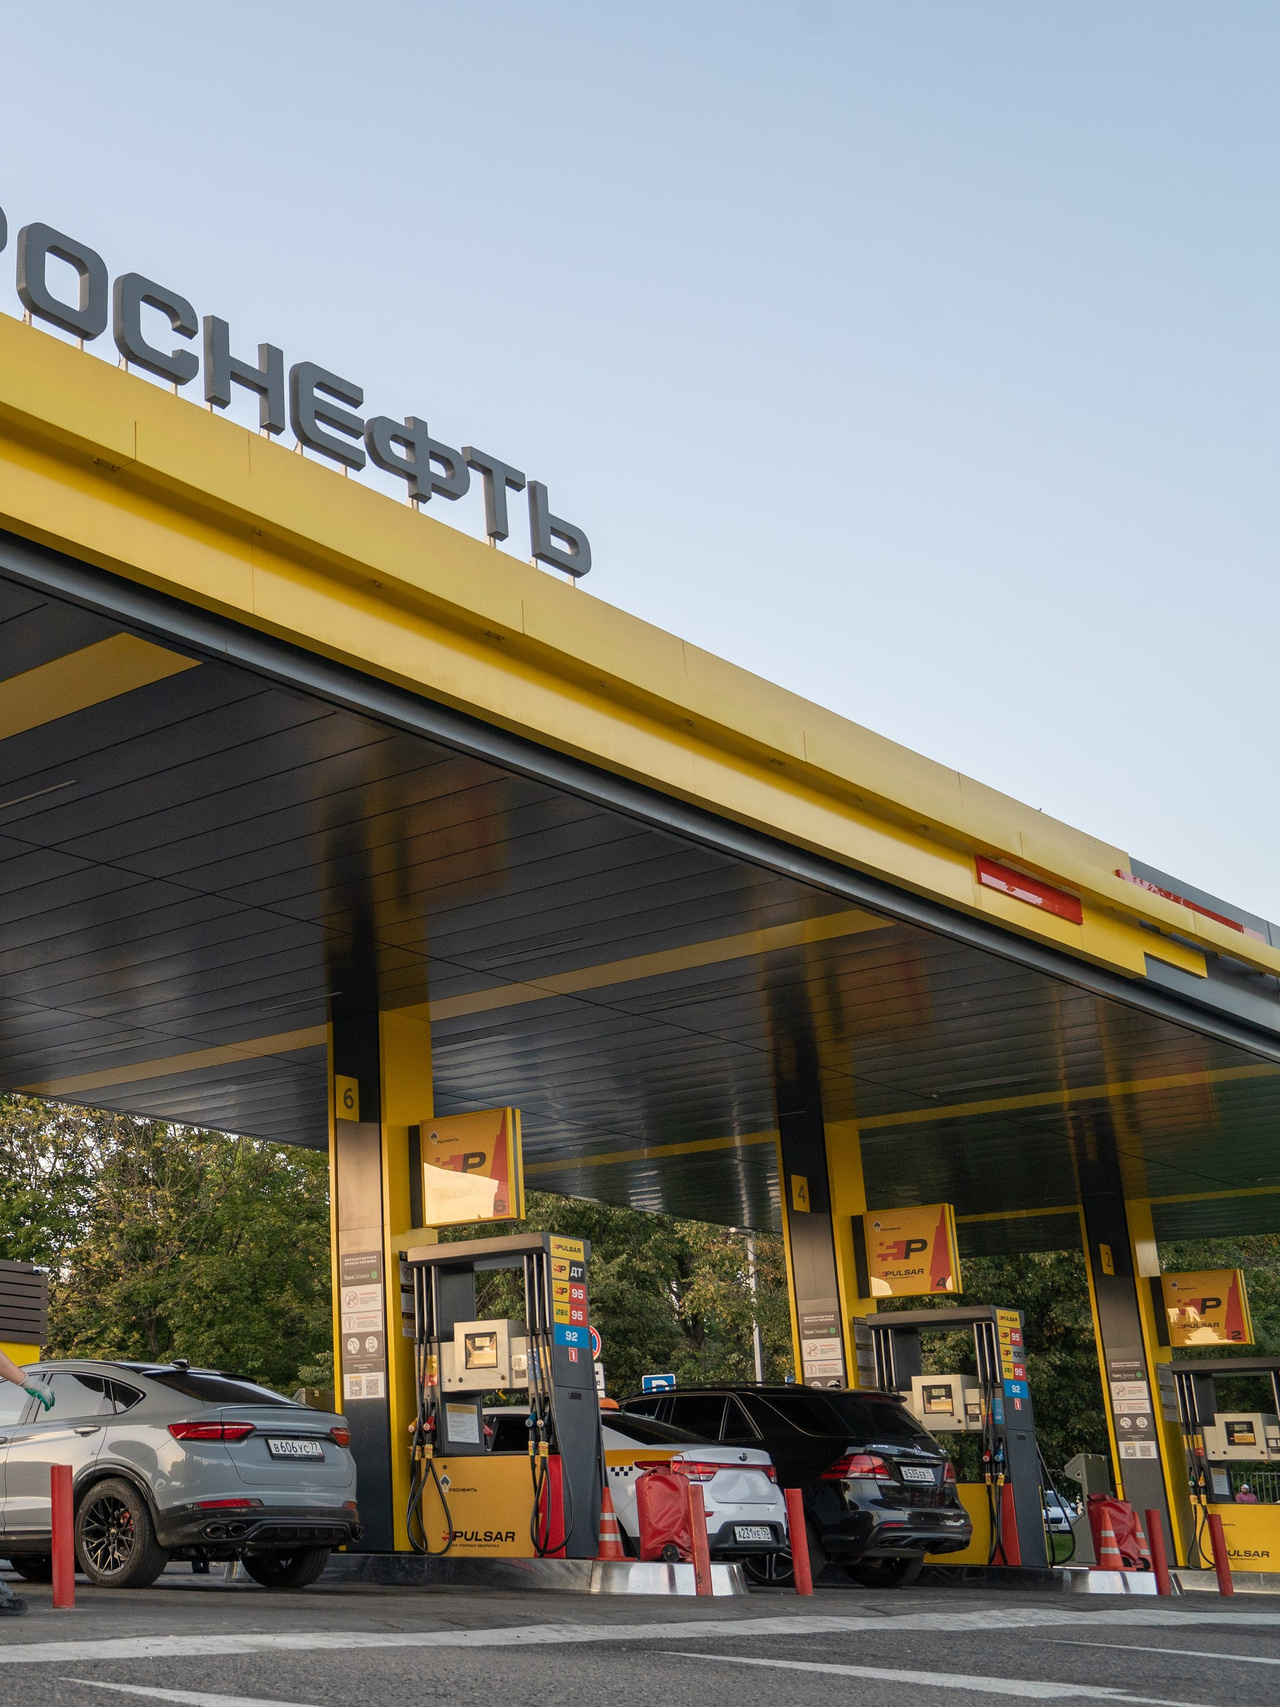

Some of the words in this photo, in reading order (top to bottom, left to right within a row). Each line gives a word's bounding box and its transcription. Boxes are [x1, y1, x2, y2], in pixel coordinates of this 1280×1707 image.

[343, 1087, 355, 1110] 6
[797, 1185, 807, 1203] 4
[557, 1243, 582, 1254] PULSAR
[903, 1238, 928, 1260] P
[1105, 1252, 1112, 1268] 2
[570, 1266, 584, 1278] ДТ
[884, 1268, 925, 1277] PULSAR
[571, 1288, 584, 1299] 95
[571, 1309, 584, 1321] 95
[1183, 1321, 1220, 1330] PULSAR
[565, 1330, 578, 1342] 92
[1011, 1333, 1020, 1342] 95
[1230, 1330, 1243, 1340] 2
[1012, 1351, 1022, 1359] 100
[1014, 1368, 1023, 1377] 95
[1011, 1384, 1021, 1394] 92
[452, 1530, 516, 1542] PULSAR
[1227, 1550, 1270, 1558] ULSAR
